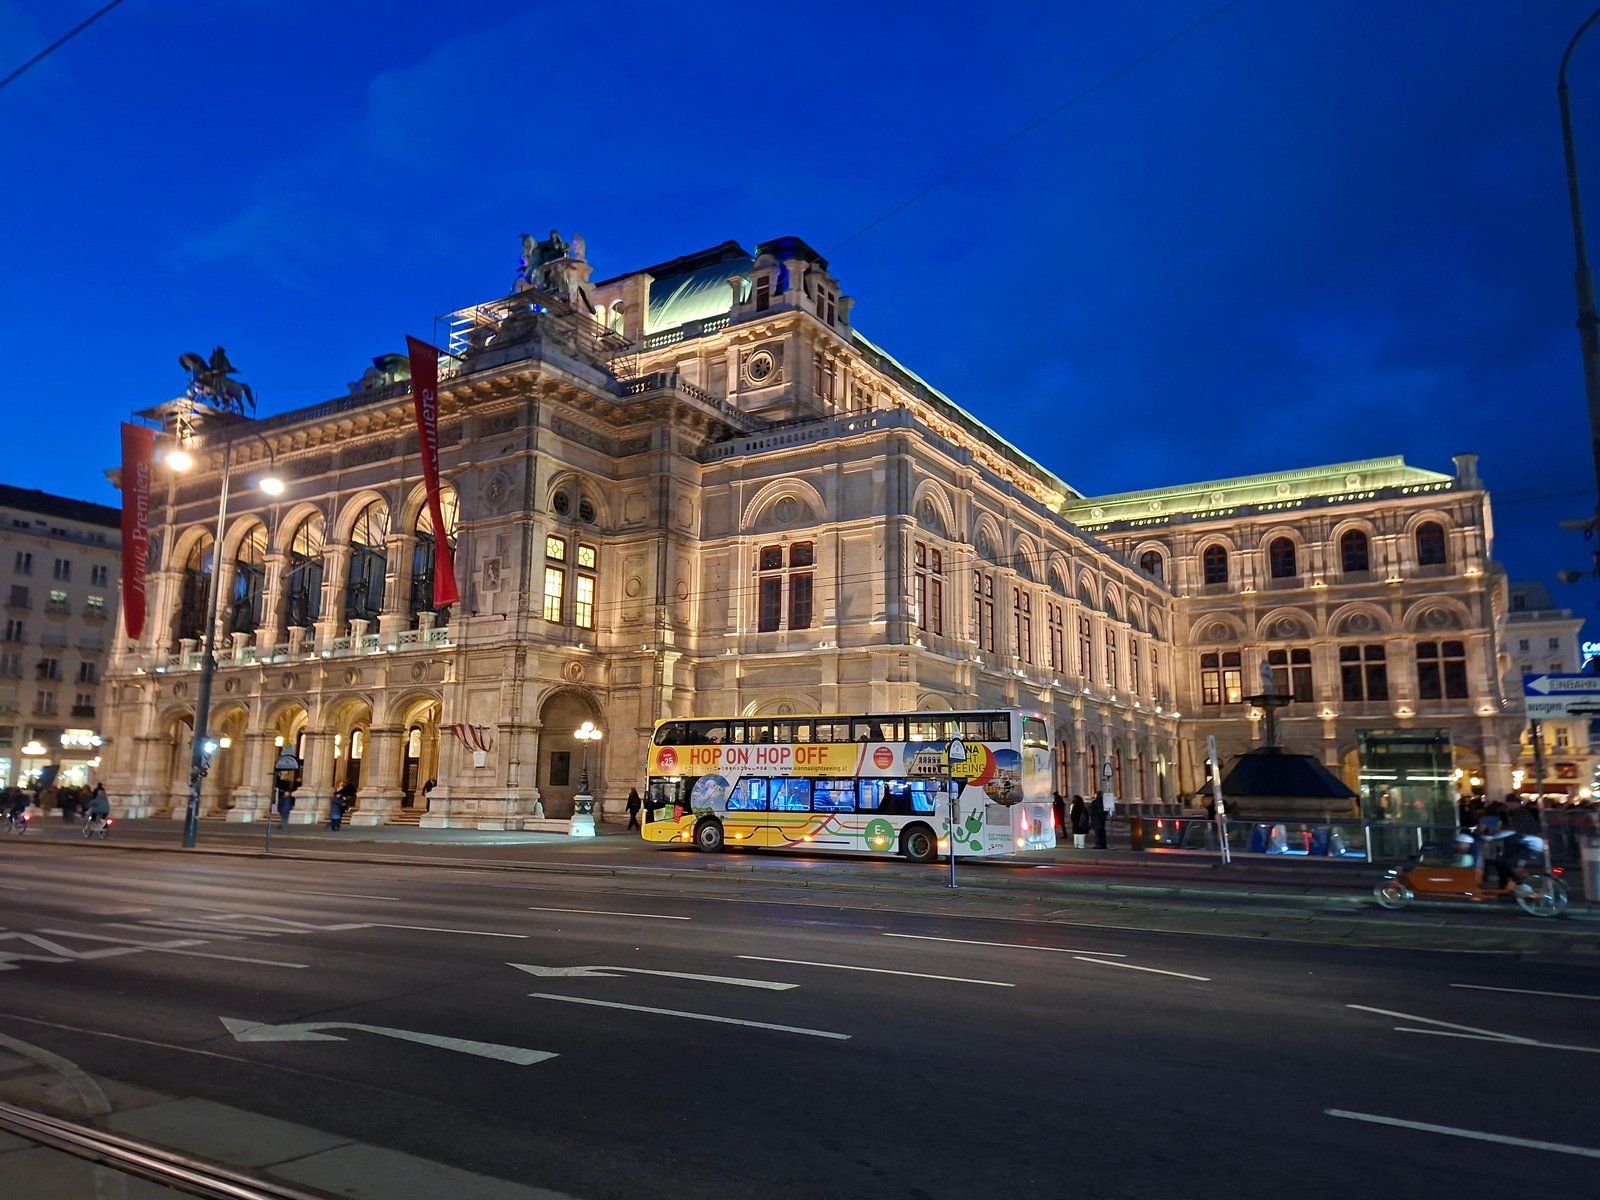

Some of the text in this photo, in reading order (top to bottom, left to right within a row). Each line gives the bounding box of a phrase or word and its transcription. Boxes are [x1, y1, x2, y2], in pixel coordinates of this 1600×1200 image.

[132, 463, 149, 542] Premiere
[690, 746, 829, 764] HOP ON HOP OFF
[875, 825, 885, 835] E-
